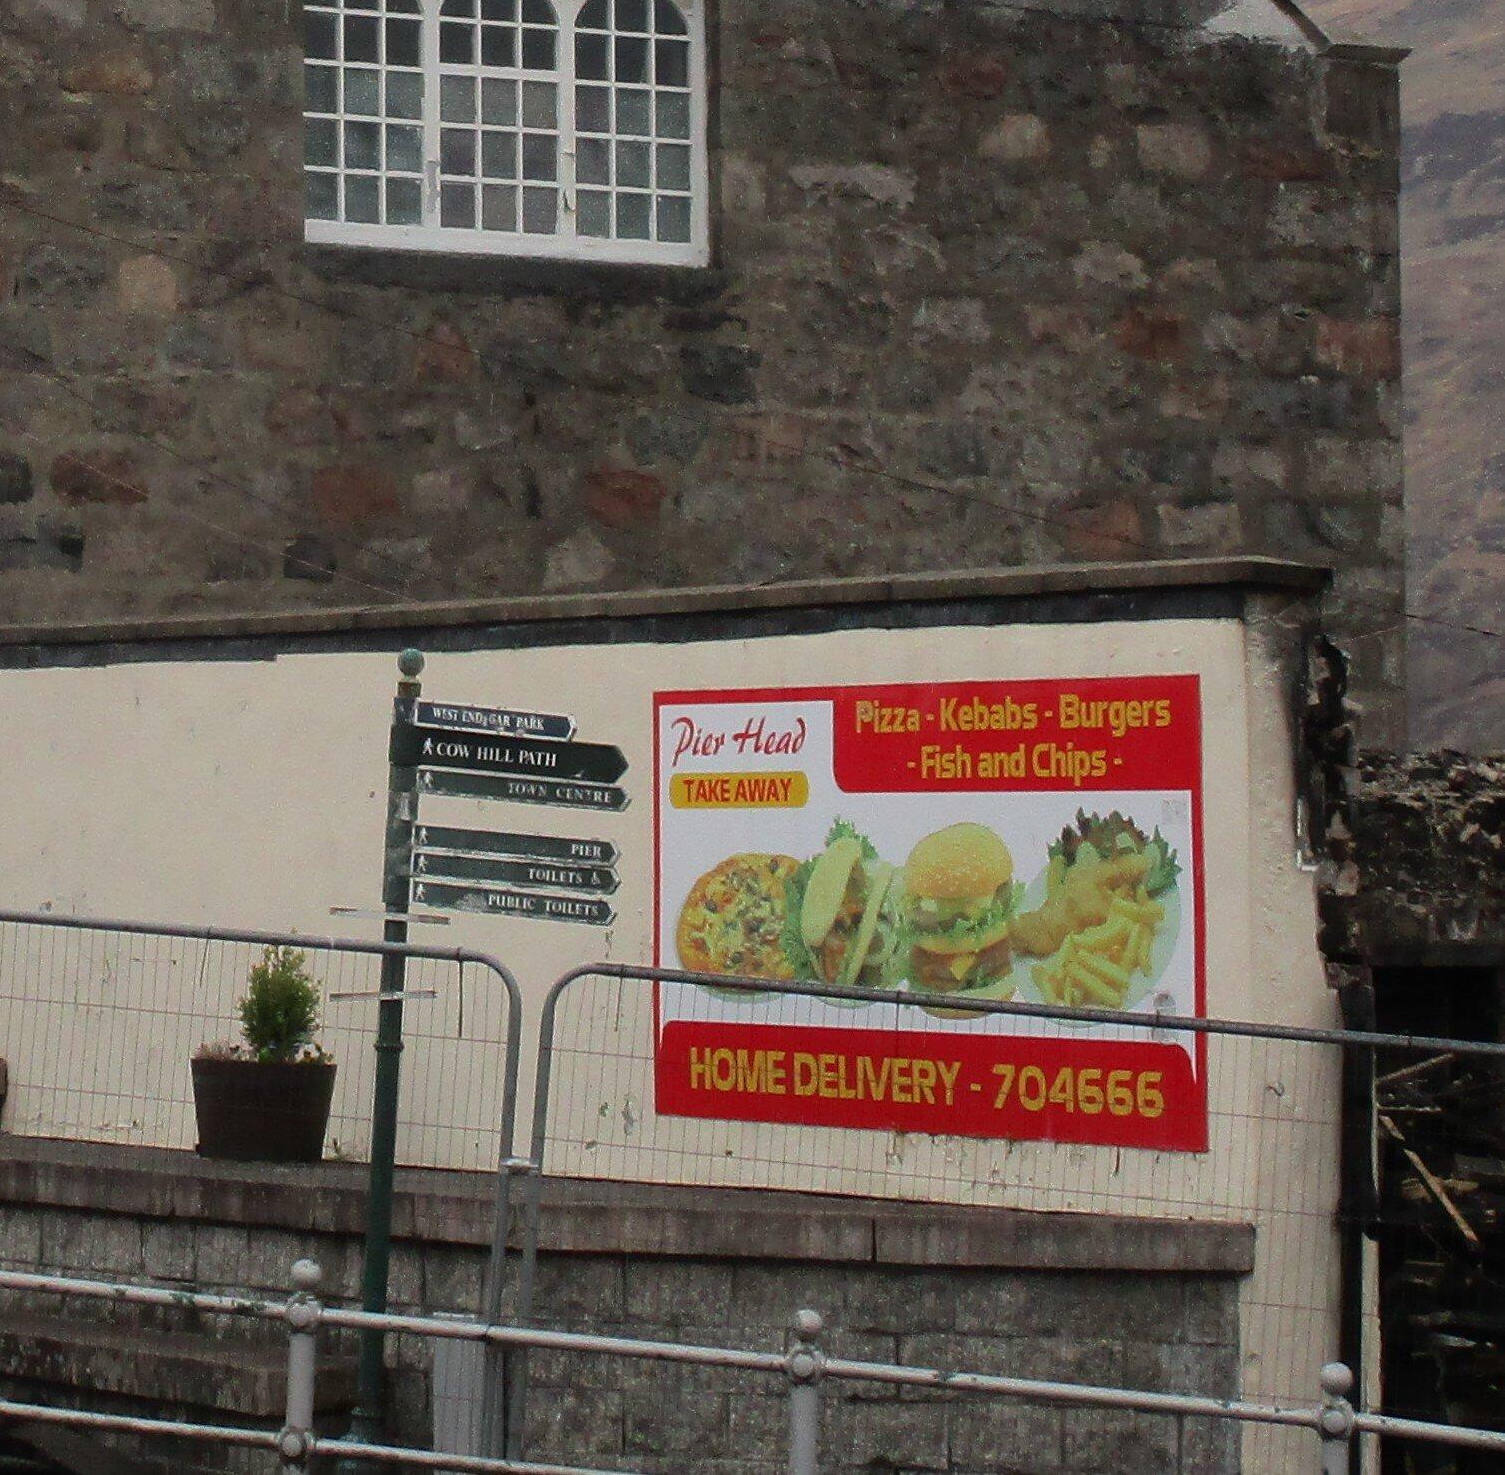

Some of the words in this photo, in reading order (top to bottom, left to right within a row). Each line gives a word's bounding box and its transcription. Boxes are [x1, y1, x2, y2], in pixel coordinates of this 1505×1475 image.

[433, 707, 459, 721] WEST
[462, 711, 483, 724] END
[516, 716, 544, 730] PARK
[855, 700, 920, 734] Pizza
[940, 695, 1038, 731] Kebabs
[1059, 693, 1172, 737] Burgers
[671, 716, 726, 767] Pier
[732, 715, 807, 755] Head
[436, 742, 470, 758] COW
[477, 746, 514, 763] HILL
[518, 750, 557, 767] PATH
[921, 744, 972, 779] Fish
[977, 743, 1025, 778] and
[1032, 742, 1107, 786] Chips
[508, 782, 547, 797] TOWN
[556, 787, 614, 803] CENTRE
[683, 778, 730, 803] TAKE
[734, 777, 792, 803] AWAY
[571, 843, 601, 857] PIER
[528, 868, 583, 884] TOILETS
[488, 894, 535, 910] PUBLIC
[544, 900, 599, 916] TOILETS
[690, 1047, 786, 1095] HOME
[794, 1052, 962, 1106] DELIVERY
[992, 1064, 1165, 1118] 704666
